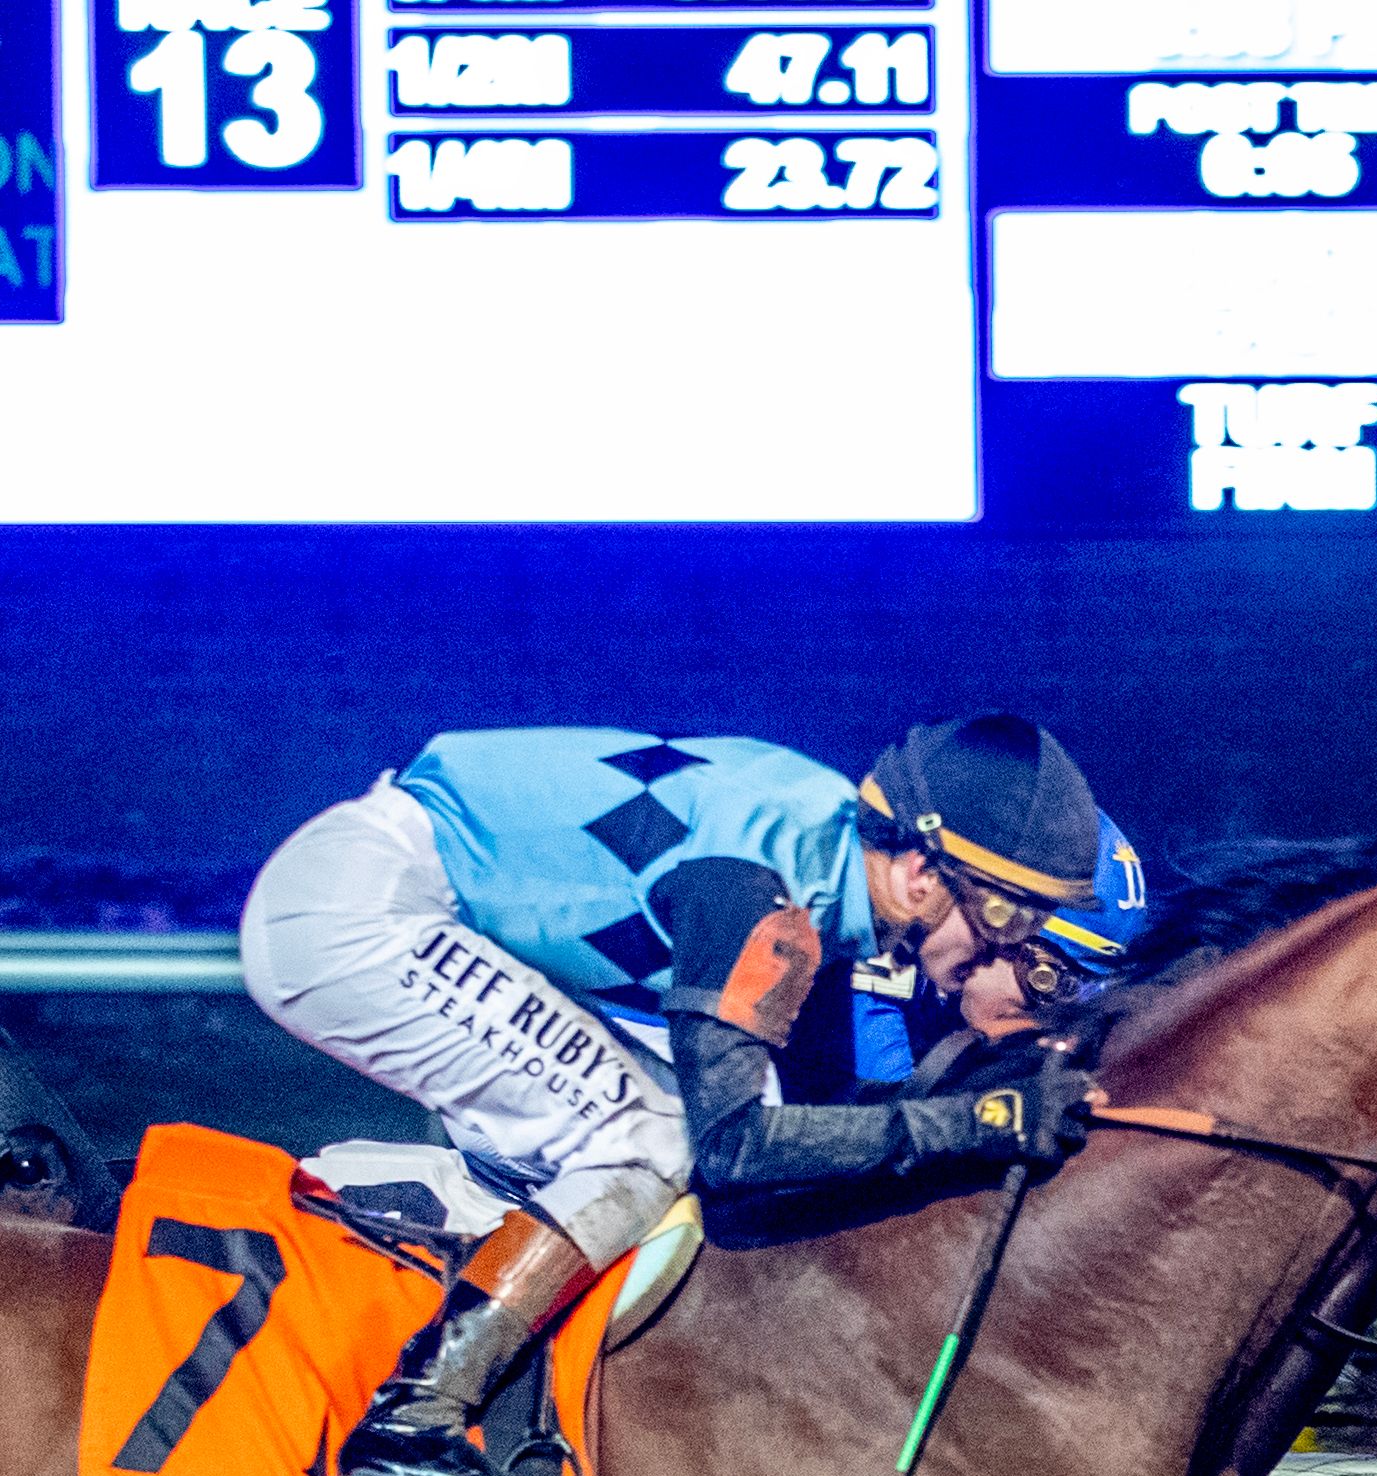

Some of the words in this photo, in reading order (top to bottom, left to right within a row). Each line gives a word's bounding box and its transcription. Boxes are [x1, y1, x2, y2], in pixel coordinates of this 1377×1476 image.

[130, 29, 326, 169] 13
[724, 32, 929, 104] 47.11
[722, 137, 940, 209] 23.72
[400, 969, 600, 1119] STEAKHOUSE
[412, 931, 513, 1003] JEFF
[508, 991, 635, 1104] RUBY'S
[110, 1216, 288, 1474] 7
